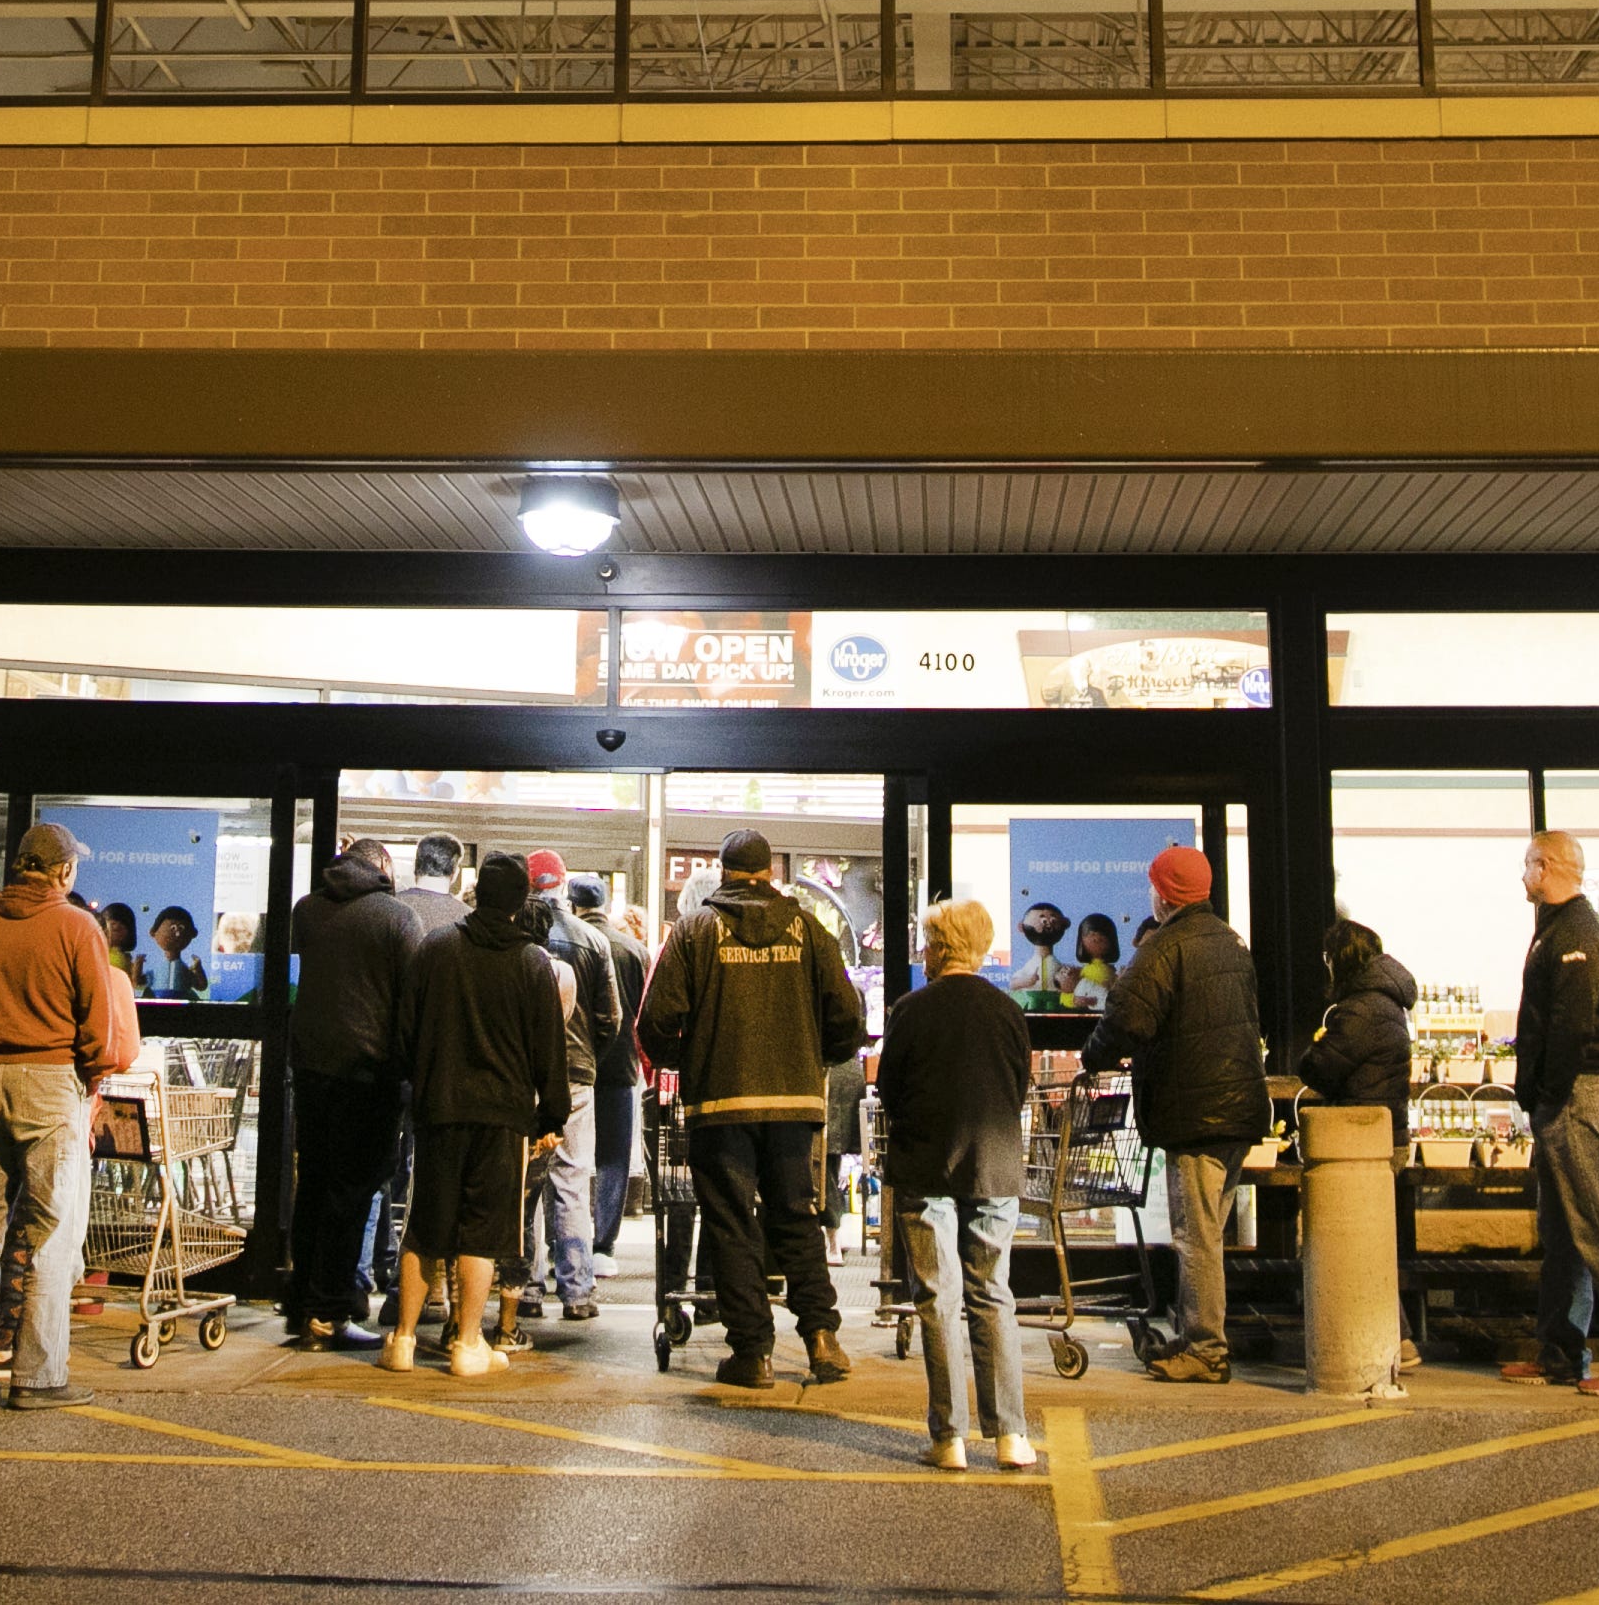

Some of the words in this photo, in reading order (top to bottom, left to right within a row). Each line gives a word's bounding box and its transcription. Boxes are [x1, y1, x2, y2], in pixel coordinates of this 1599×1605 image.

[694, 634, 794, 662] OPEN
[834, 641, 886, 680] Kroger
[919, 652, 975, 671] 4100
[661, 663, 702, 680] DAY
[706, 663, 755, 680] PICK
[760, 663, 795, 680] UP!
[822, 688, 895, 699] Kroger.com
[99, 851, 125, 864] FOR
[1028, 860, 1069, 873] FRESH
[1074, 861, 1101, 873] FOR
[719, 946, 770, 963] SERVICE
